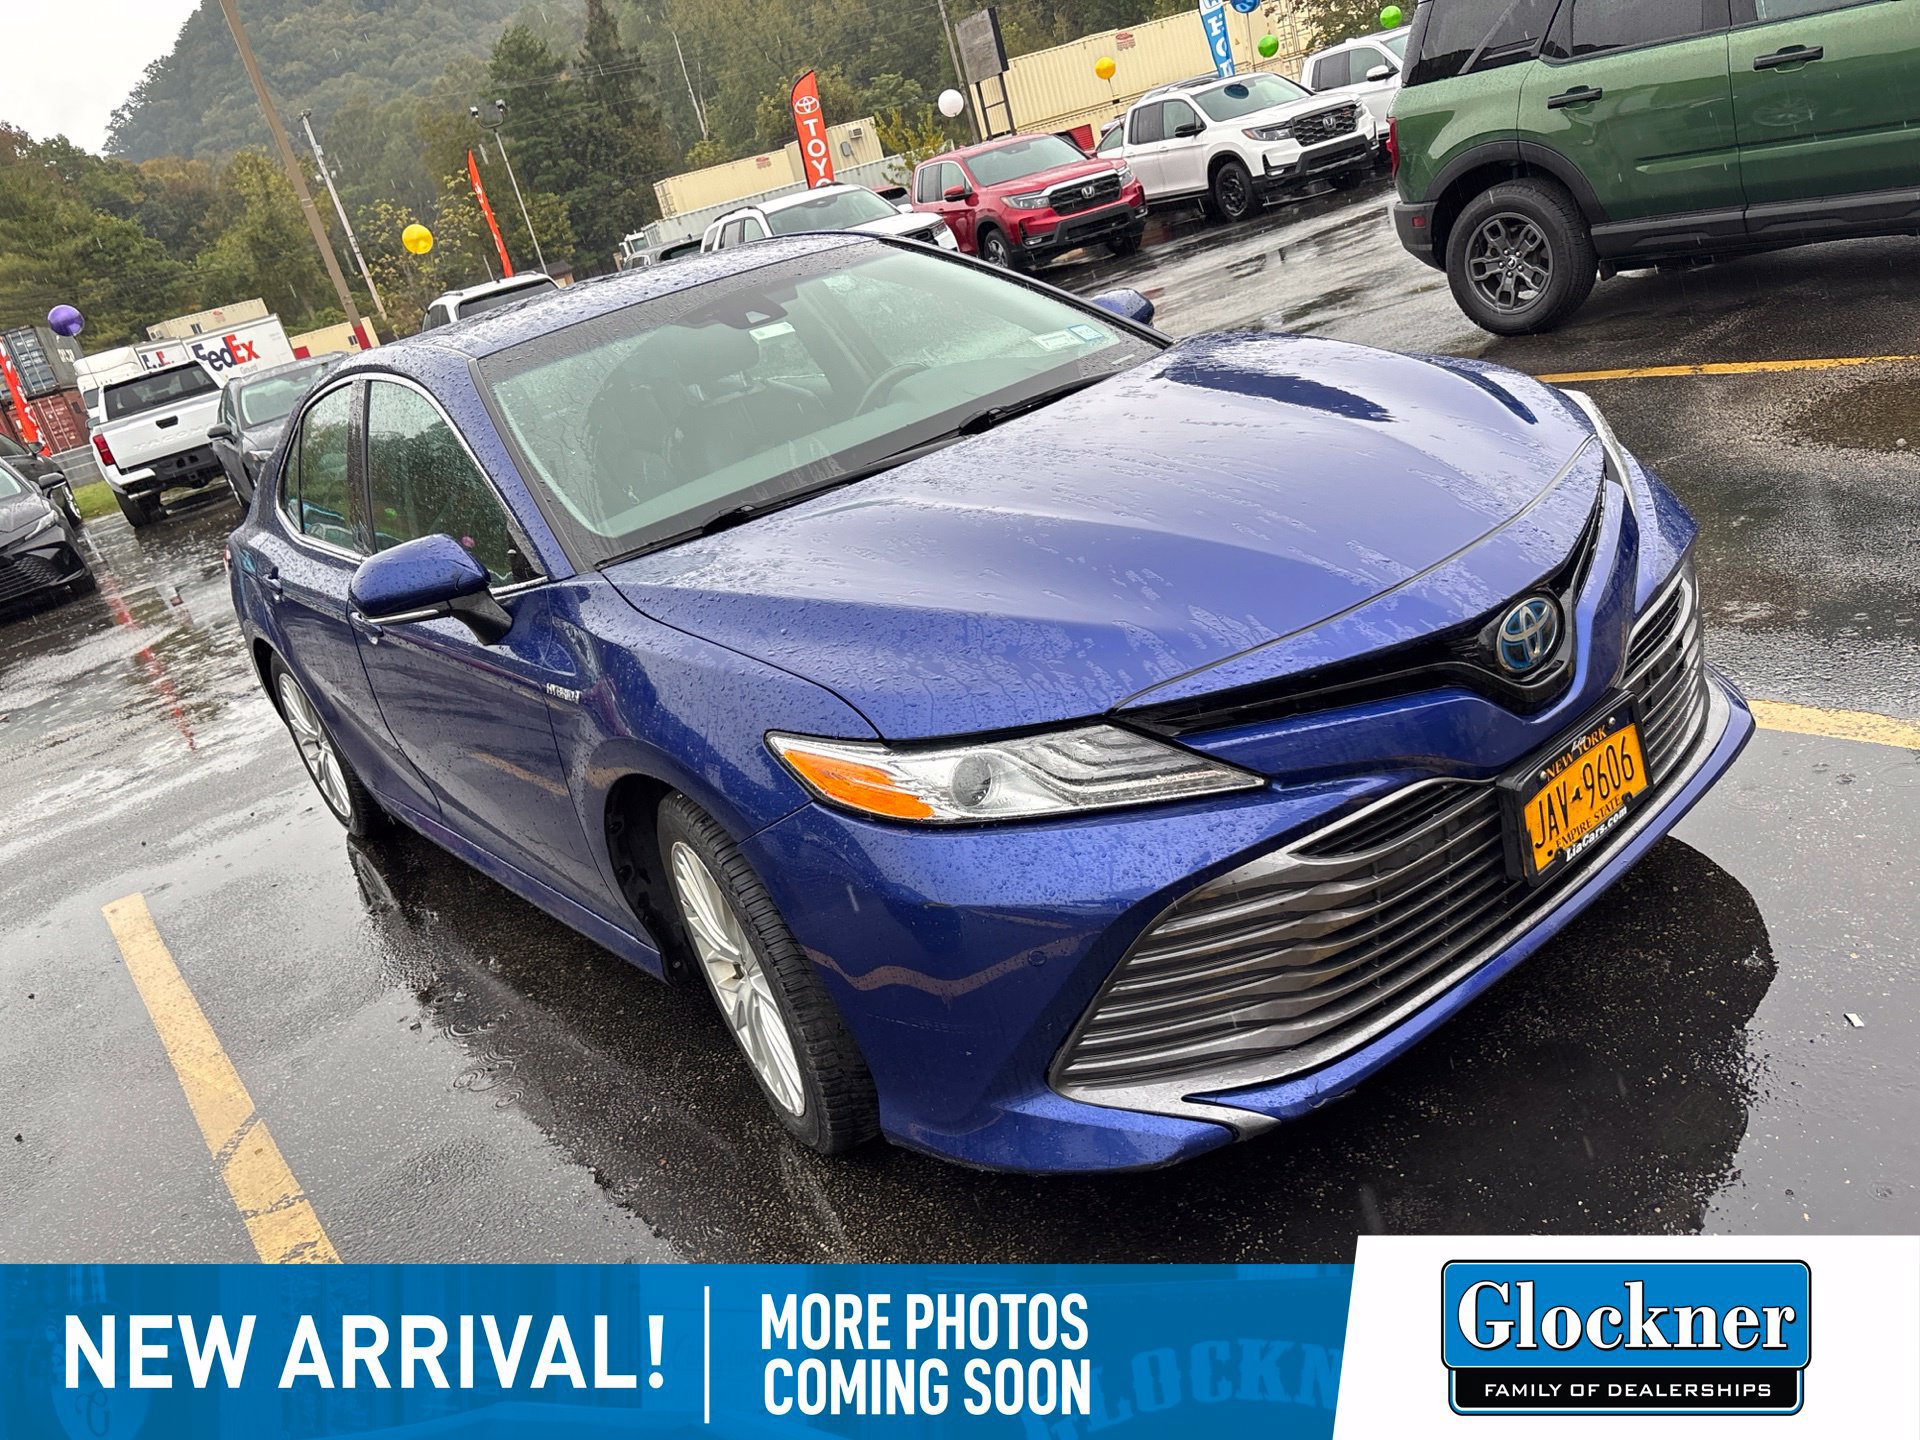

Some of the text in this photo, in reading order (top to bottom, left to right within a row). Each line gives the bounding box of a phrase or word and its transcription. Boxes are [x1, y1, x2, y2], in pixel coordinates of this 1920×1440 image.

[191, 333, 261, 371] FedEx
[1576, 725, 1607, 755] YORK
[1546, 754, 1574, 780] NEW
[1556, 794, 1622, 849] EMPIRE STATE
[1566, 805, 1628, 862] LiaCars.com
